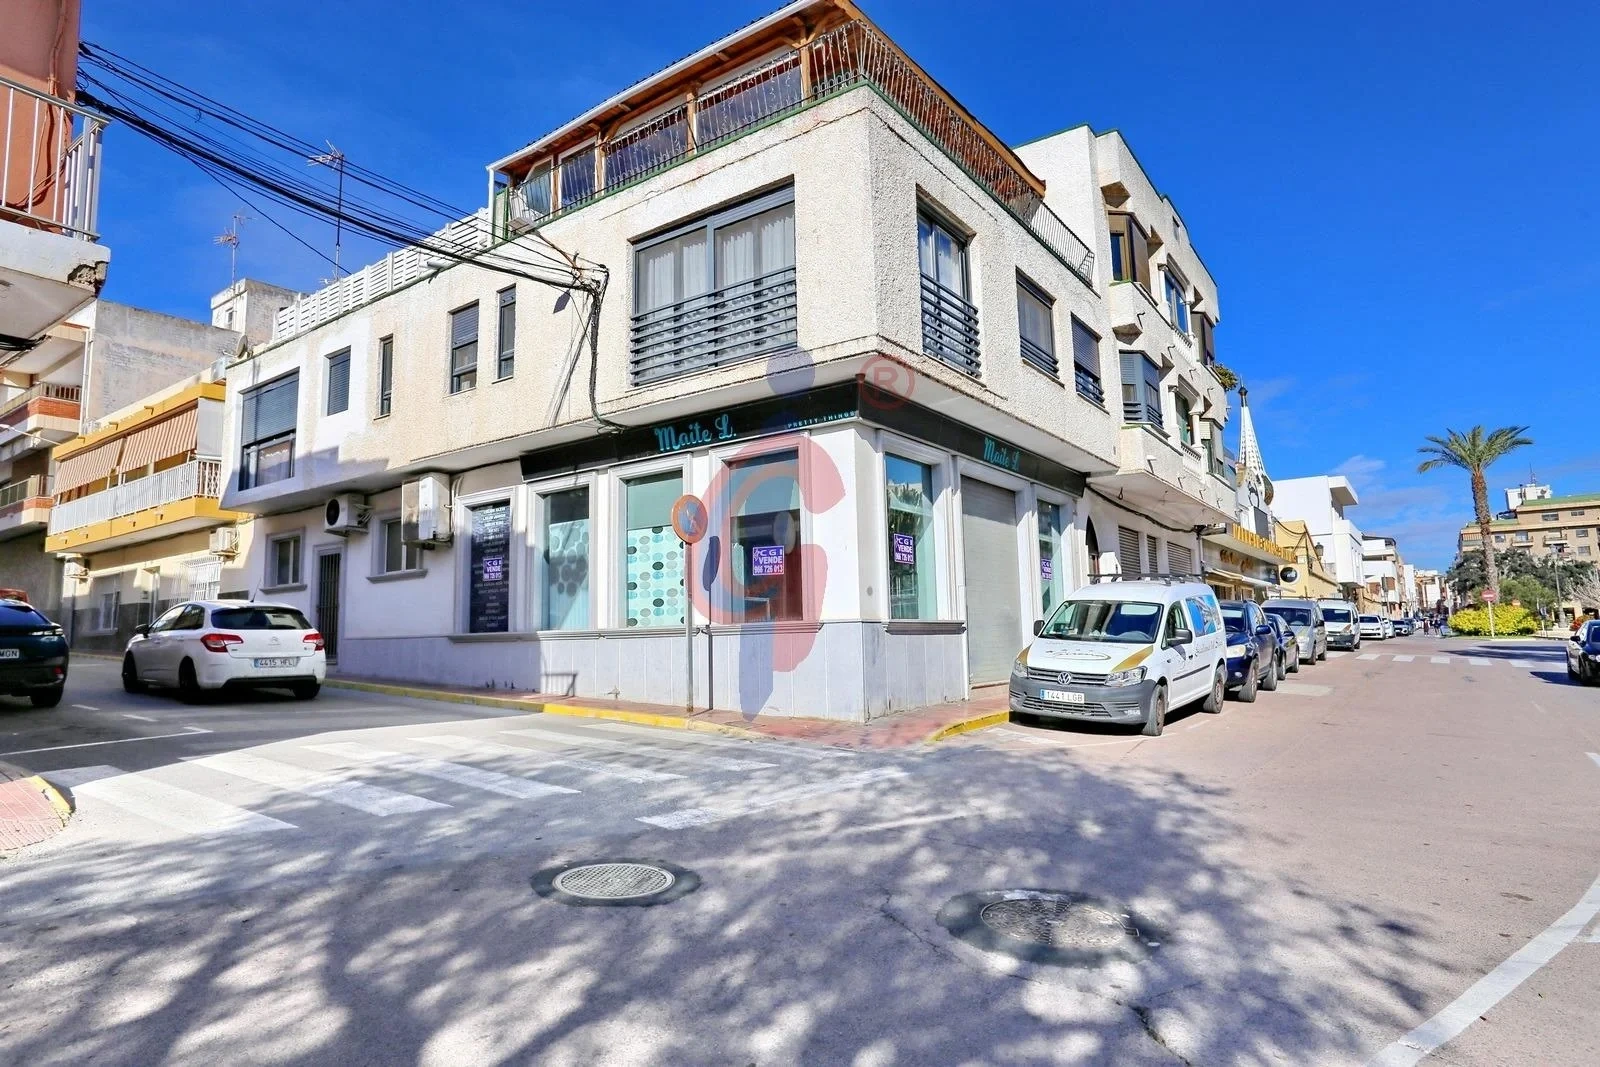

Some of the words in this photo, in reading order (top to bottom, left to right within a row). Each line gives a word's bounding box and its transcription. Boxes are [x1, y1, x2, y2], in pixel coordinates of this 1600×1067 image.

[787, 417, 818, 429] PRETTY
[823, 410, 855, 422] THINGS
[654, 421, 713, 451] Maite
[714, 413, 737, 439] L.
[983, 437, 1009, 468] Maite
[759, 556, 783, 564] VENDE
[764, 565, 773, 573] 726
[1047, 691, 1065, 700] 1441
[1067, 694, 1083, 702] LGB
